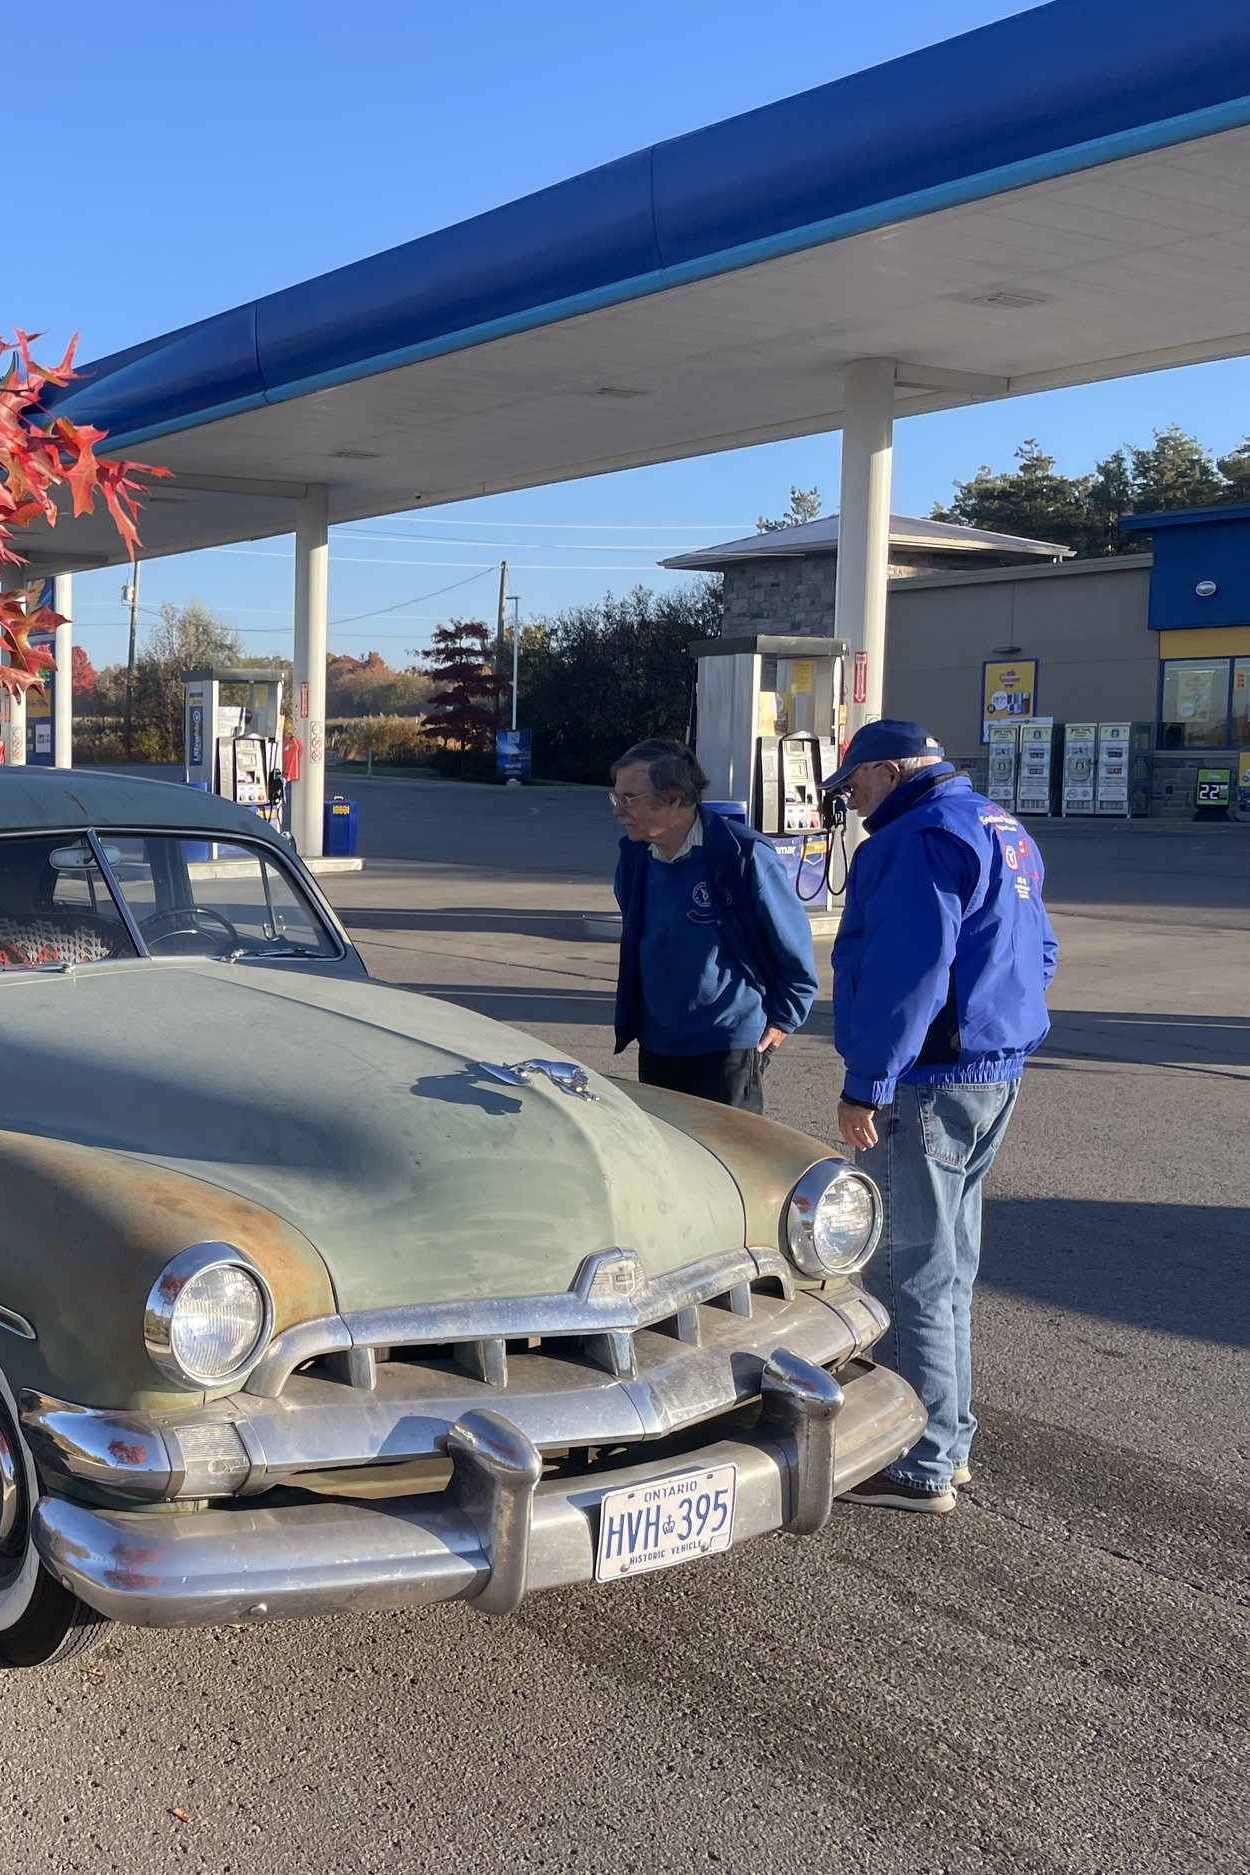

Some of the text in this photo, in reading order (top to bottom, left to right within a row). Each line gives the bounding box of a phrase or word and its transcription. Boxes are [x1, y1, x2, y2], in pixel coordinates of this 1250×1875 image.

[1199, 784, 1220, 800] 22
[644, 1480, 698, 1503] ONTARIO
[605, 1487, 729, 1560] HVH 395
[630, 1539, 703, 1565] HISTORIC VEHICLE
